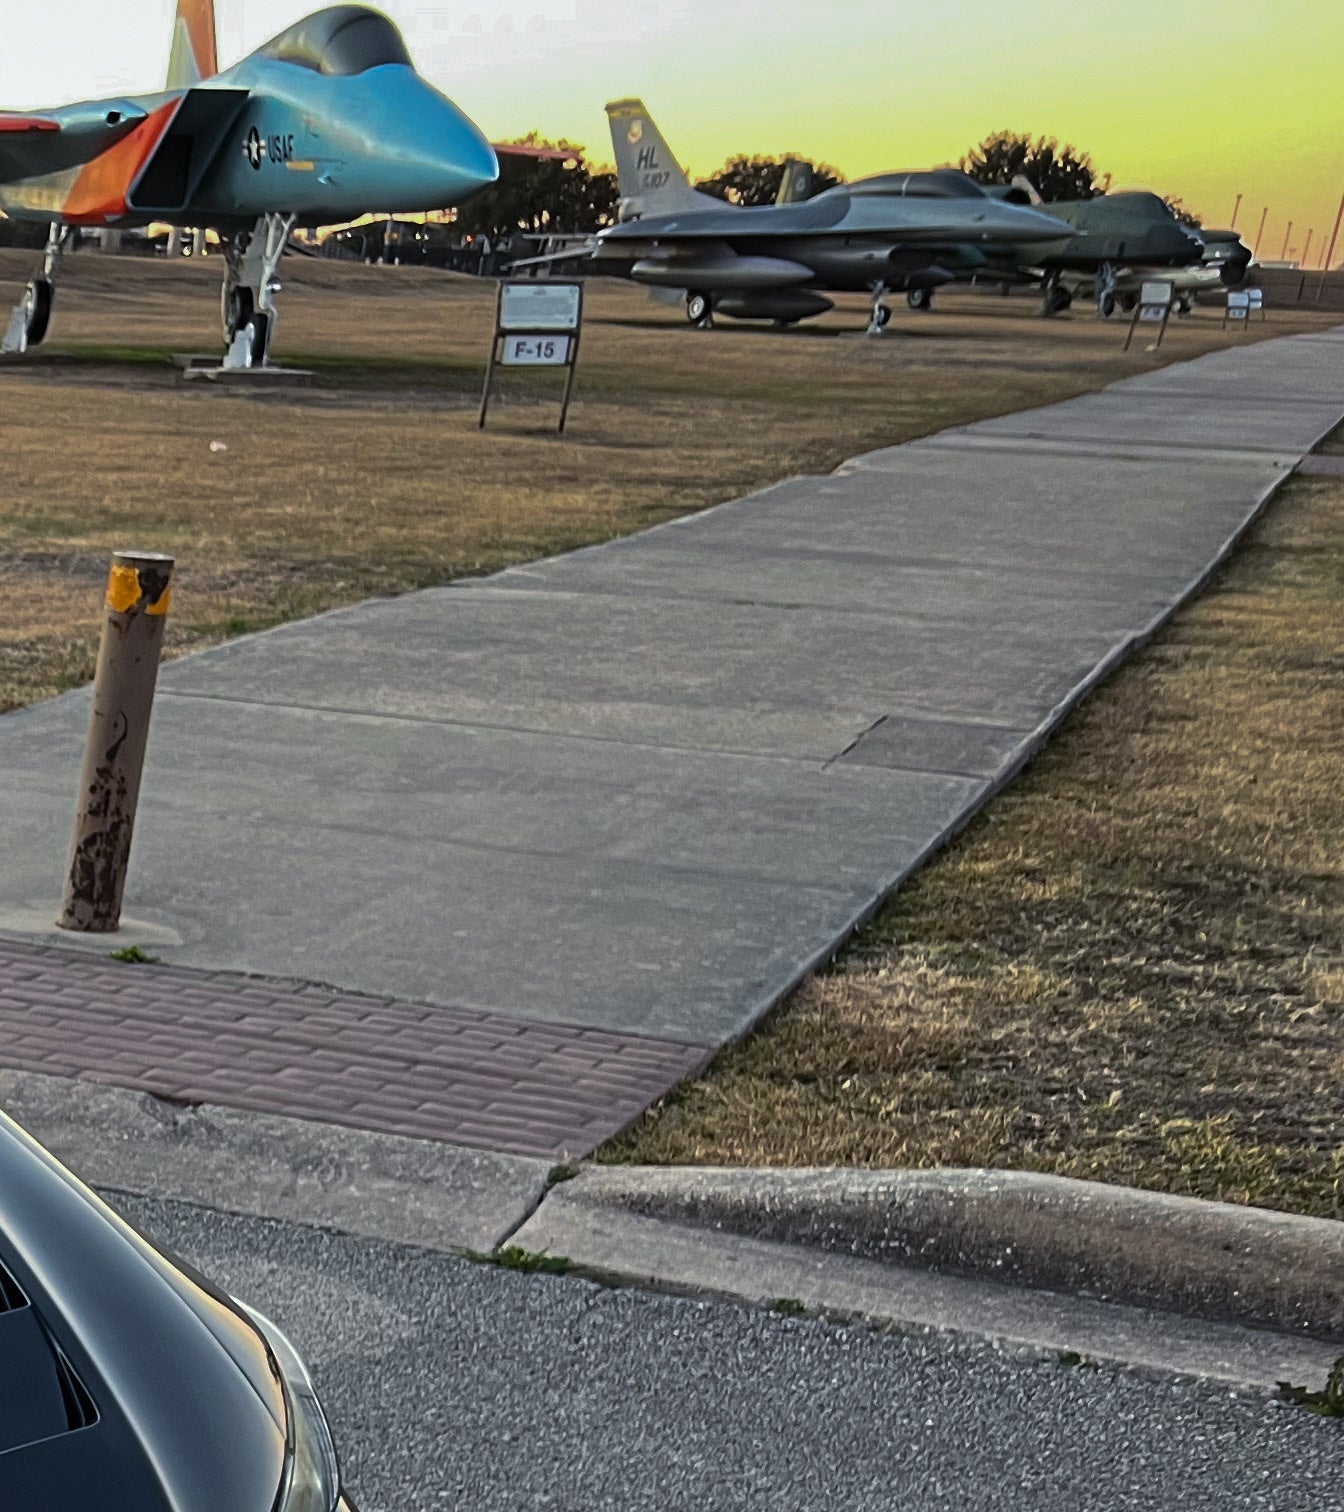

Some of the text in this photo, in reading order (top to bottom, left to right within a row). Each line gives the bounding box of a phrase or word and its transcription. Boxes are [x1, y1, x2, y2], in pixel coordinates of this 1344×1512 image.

[267, 133, 294, 163] USAF
[637, 145, 659, 169] HL
[514, 341, 556, 359] F-15
